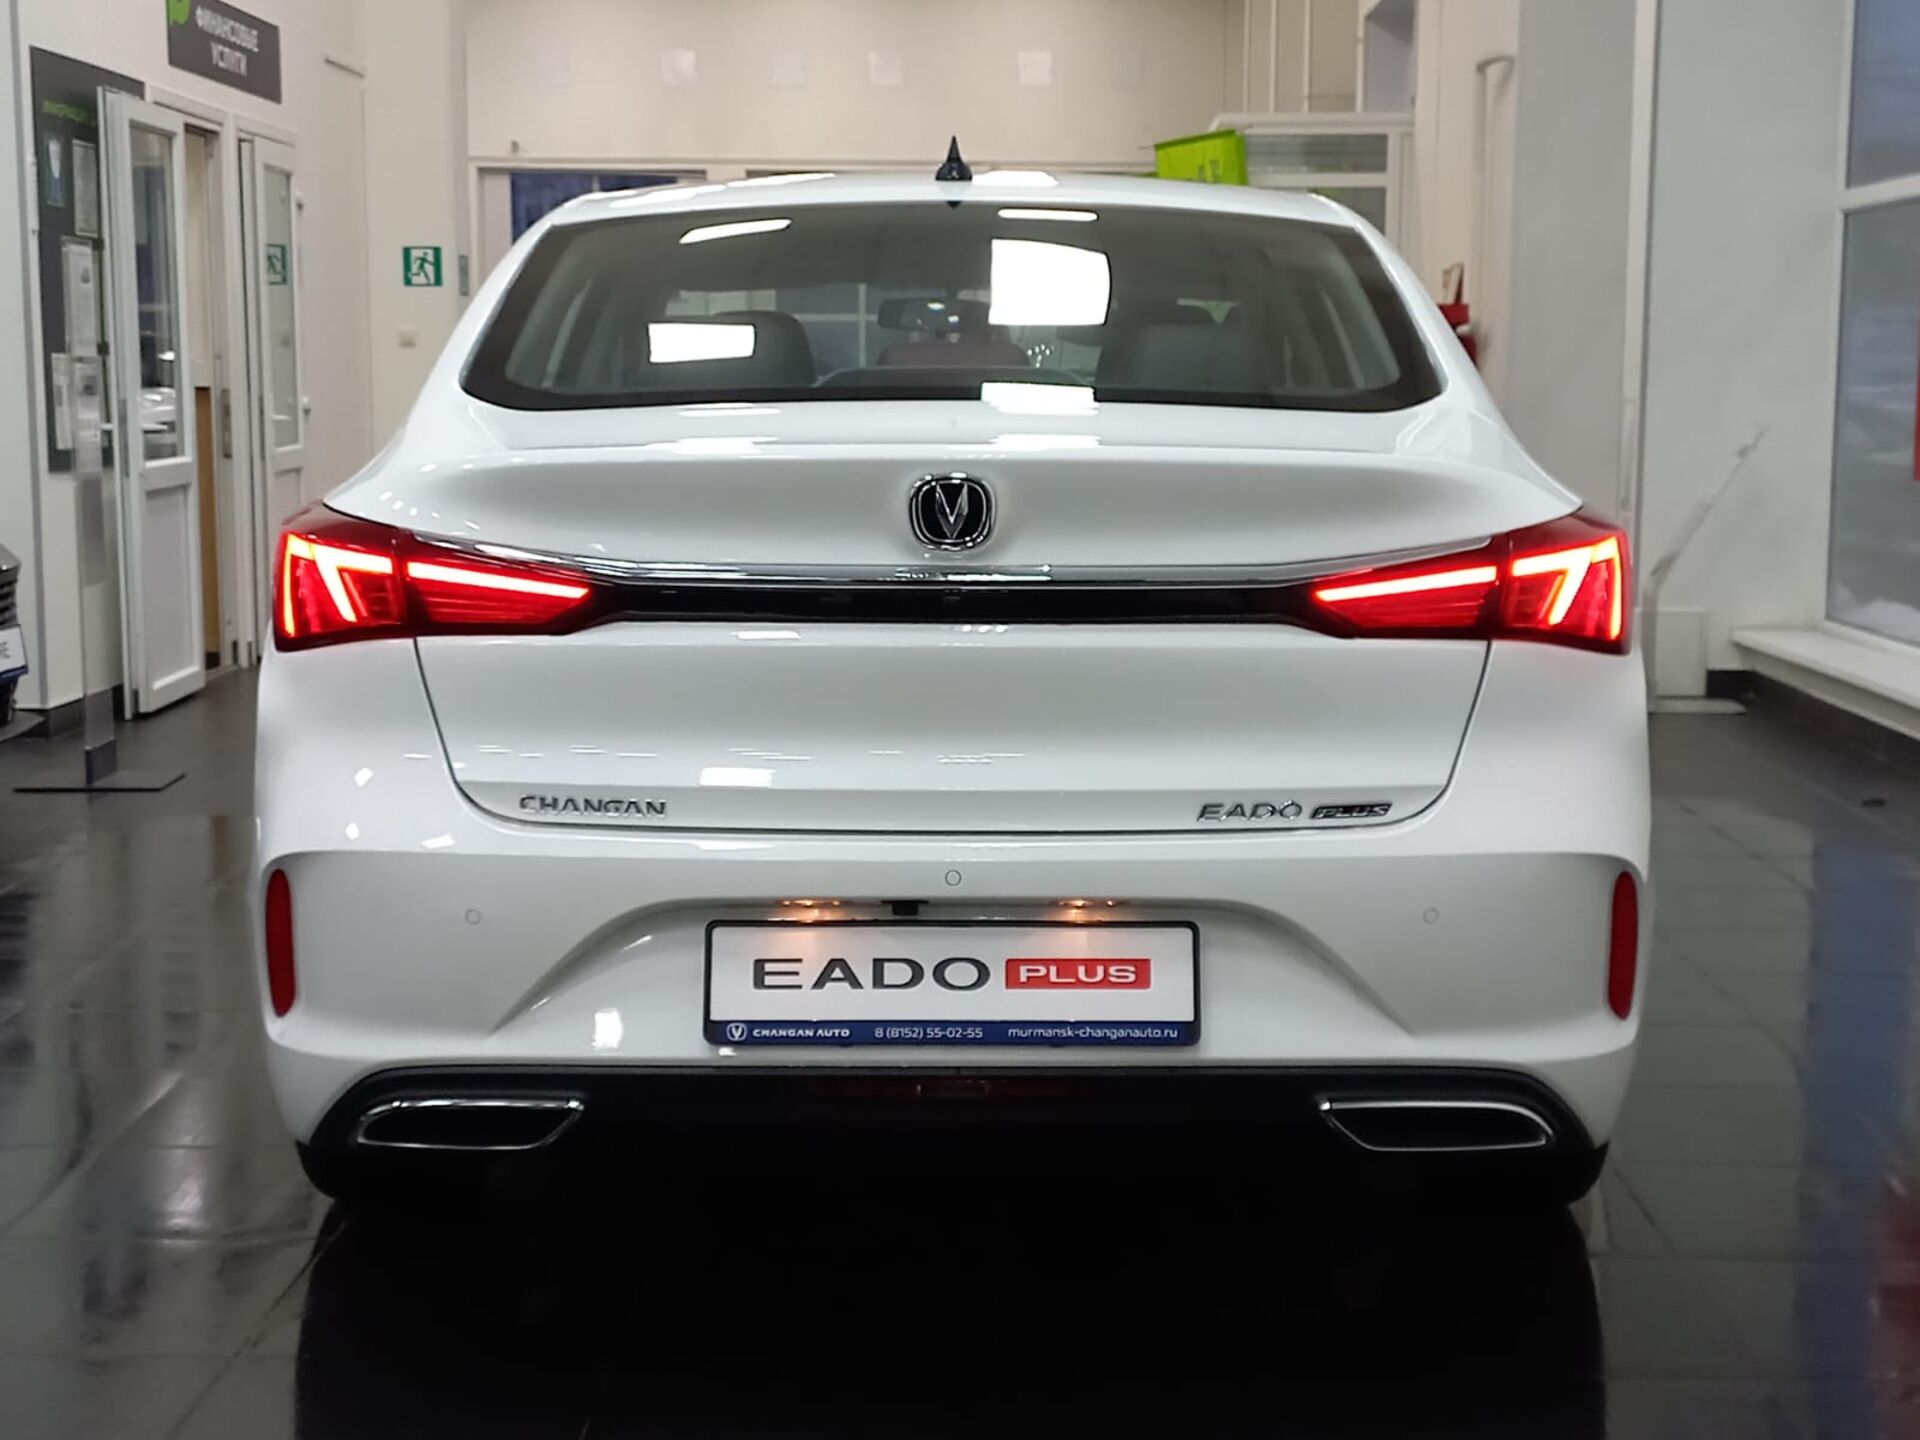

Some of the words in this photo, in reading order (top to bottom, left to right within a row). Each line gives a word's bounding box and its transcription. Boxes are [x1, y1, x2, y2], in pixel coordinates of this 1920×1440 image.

[519, 795, 666, 816] CHANGAN
[1197, 800, 1303, 821] EADO
[1314, 804, 1390, 818] PLUS
[753, 957, 991, 991] EADO
[1019, 965, 1137, 983] PLUS
[752, 1028, 814, 1038] CHANGAN
[816, 1028, 850, 1038] AUTO
[874, 1027, 884, 1039] 8
[886, 1027, 924, 1040] (8152)
[926, 1027, 983, 1039] 55-02-55
[1007, 1026, 1178, 1040] murmansk-changanauto.ru
